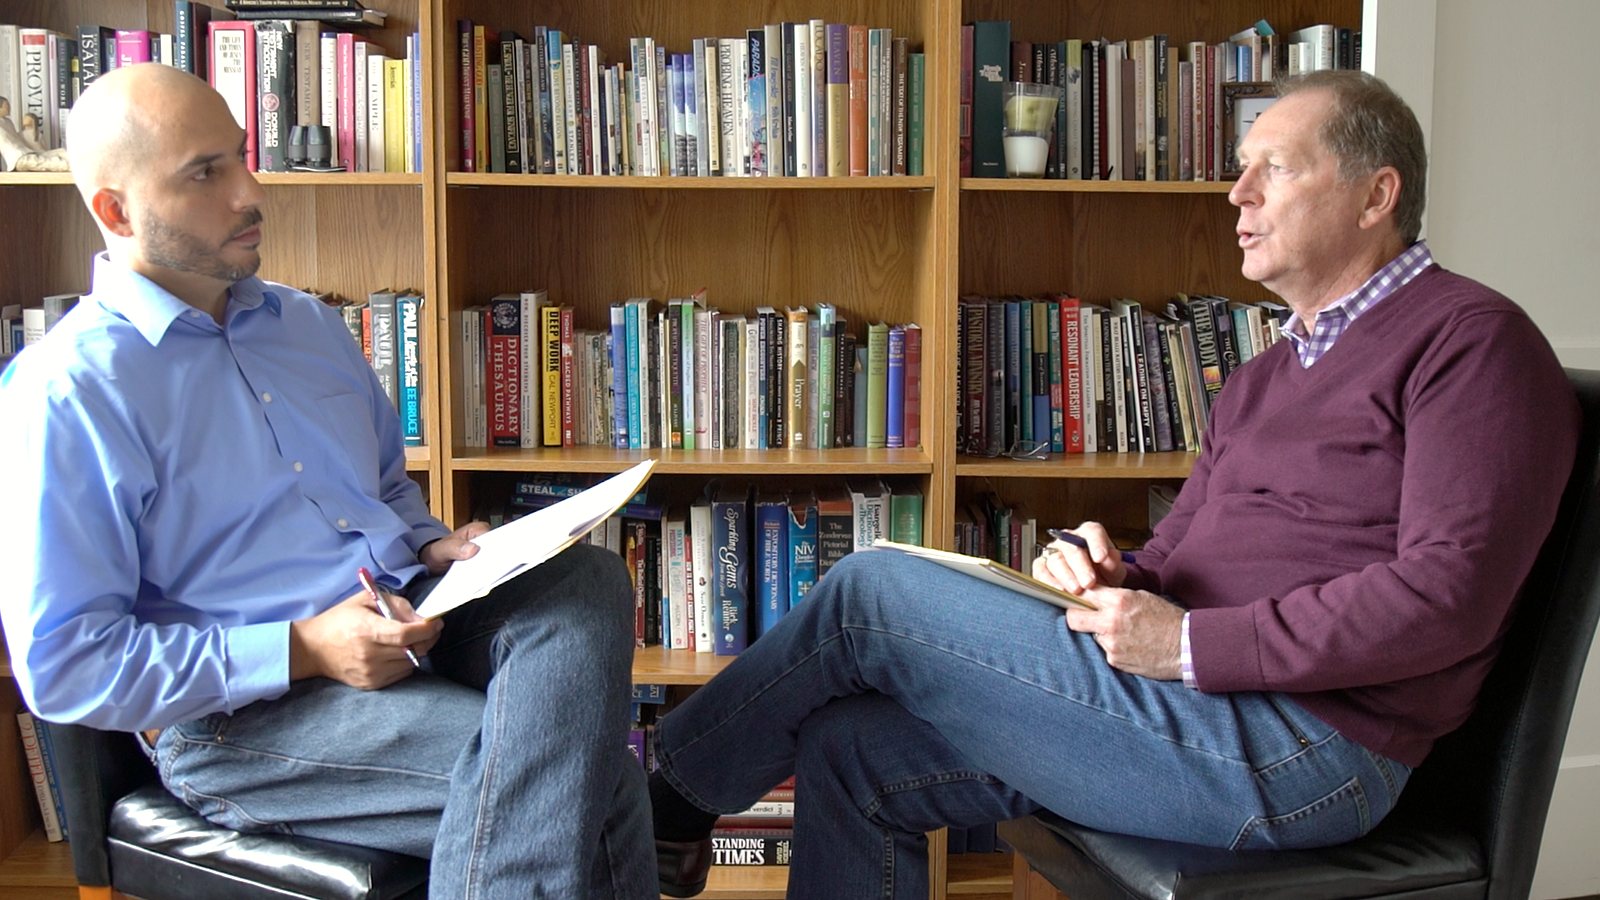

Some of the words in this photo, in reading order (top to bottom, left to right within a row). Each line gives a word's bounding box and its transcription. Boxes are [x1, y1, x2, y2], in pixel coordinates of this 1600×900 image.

[263, 31, 271, 92] INTRODUCTION
[303, 43, 311, 62] NEW
[475, 34, 483, 69] TRUSTING
[751, 38, 761, 81] PARADIS
[814, 24, 824, 72] LUCADO
[832, 32, 842, 76] HEAVEN
[720, 44, 732, 89] PROBING
[304, 67, 312, 118] TESTAMENT
[898, 98, 904, 106] OF
[722, 93, 734, 136] HEAVEN
[404, 303, 417, 341] PAUL
[549, 311, 559, 337] DEEP
[968, 309, 984, 352] PASTORAL
[1195, 303, 1210, 332] THE
[374, 313, 394, 370] PAUL
[549, 340, 559, 372] WORK
[700, 350, 707, 359] OF
[1066, 321, 1078, 366] RESONANT
[1197, 332, 1218, 366] BODY
[494, 341, 504, 431] THESAURUS
[507, 338, 518, 435] DICTIONARY
[968, 356, 984, 395] MINISTRY
[1137, 353, 1147, 387] LEADING
[549, 391, 557, 429] NEWPORT
[793, 378, 805, 409] Prayer
[1068, 368, 1080, 420] LEADERSHIP
[1140, 389, 1148, 400] ON
[408, 401, 418, 433] BRUCE
[993, 390, 1001, 436] BLACKABY
[1142, 401, 1150, 427] EMPTY
[521, 484, 555, 495] STEAL
[723, 508, 739, 551] Sparkling
[765, 529, 771, 538] OF
[857, 509, 867, 548] Theology
[872, 504, 881, 540] Evangelic
[718, 546, 739, 589] Gems
[795, 545, 815, 555] NIV
[637, 568, 645, 587] Radical
[771, 571, 779, 610] DICTIONARY
[637, 587, 645, 608] Christian
[729, 606, 738, 624] Rick
[722, 600, 731, 631] Renner
[712, 838, 765, 849] STANDING
[713, 849, 765, 865] TIMES
